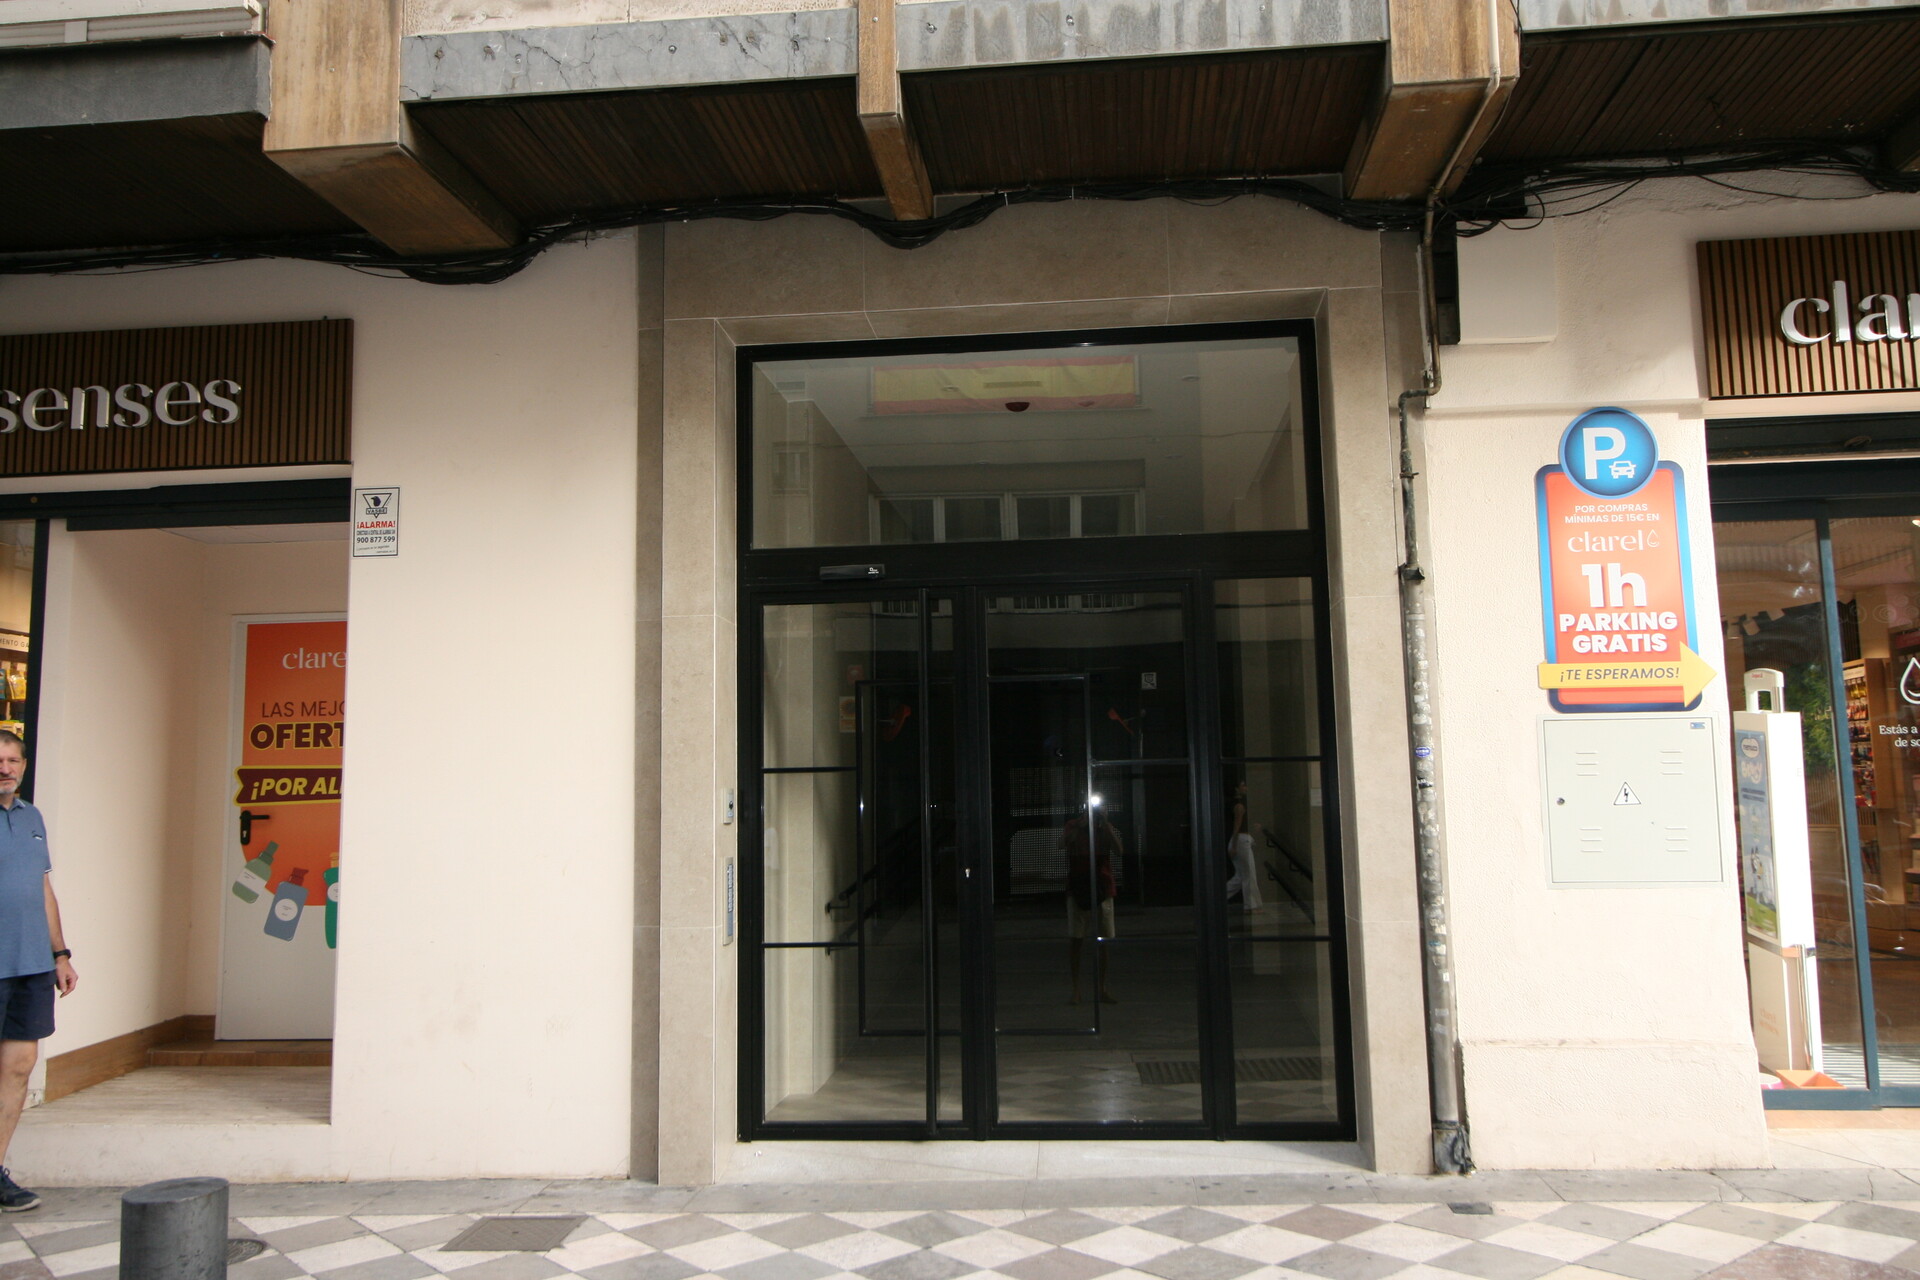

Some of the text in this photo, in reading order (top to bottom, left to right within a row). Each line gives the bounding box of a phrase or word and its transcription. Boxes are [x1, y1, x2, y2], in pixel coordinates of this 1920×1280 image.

[1583, 427, 1626, 480] P
[1574, 503, 1648, 513] POR COMPRAS
[1565, 513, 1660, 524] MÍNIMAS DE 15€ EN
[1567, 529, 1644, 552] clarel
[1581, 563, 1647, 608] 1h
[1559, 611, 1678, 632] PARKING
[1572, 633, 1668, 653] GRATIS
[1560, 667, 1680, 682] ¡TE ESPERAMOS!
[262, 702, 294, 718] LAS
[1879, 724, 1918, 735] Estás a
[1894, 737, 1908, 747] de
[251, 777, 308, 801] ¡POR
